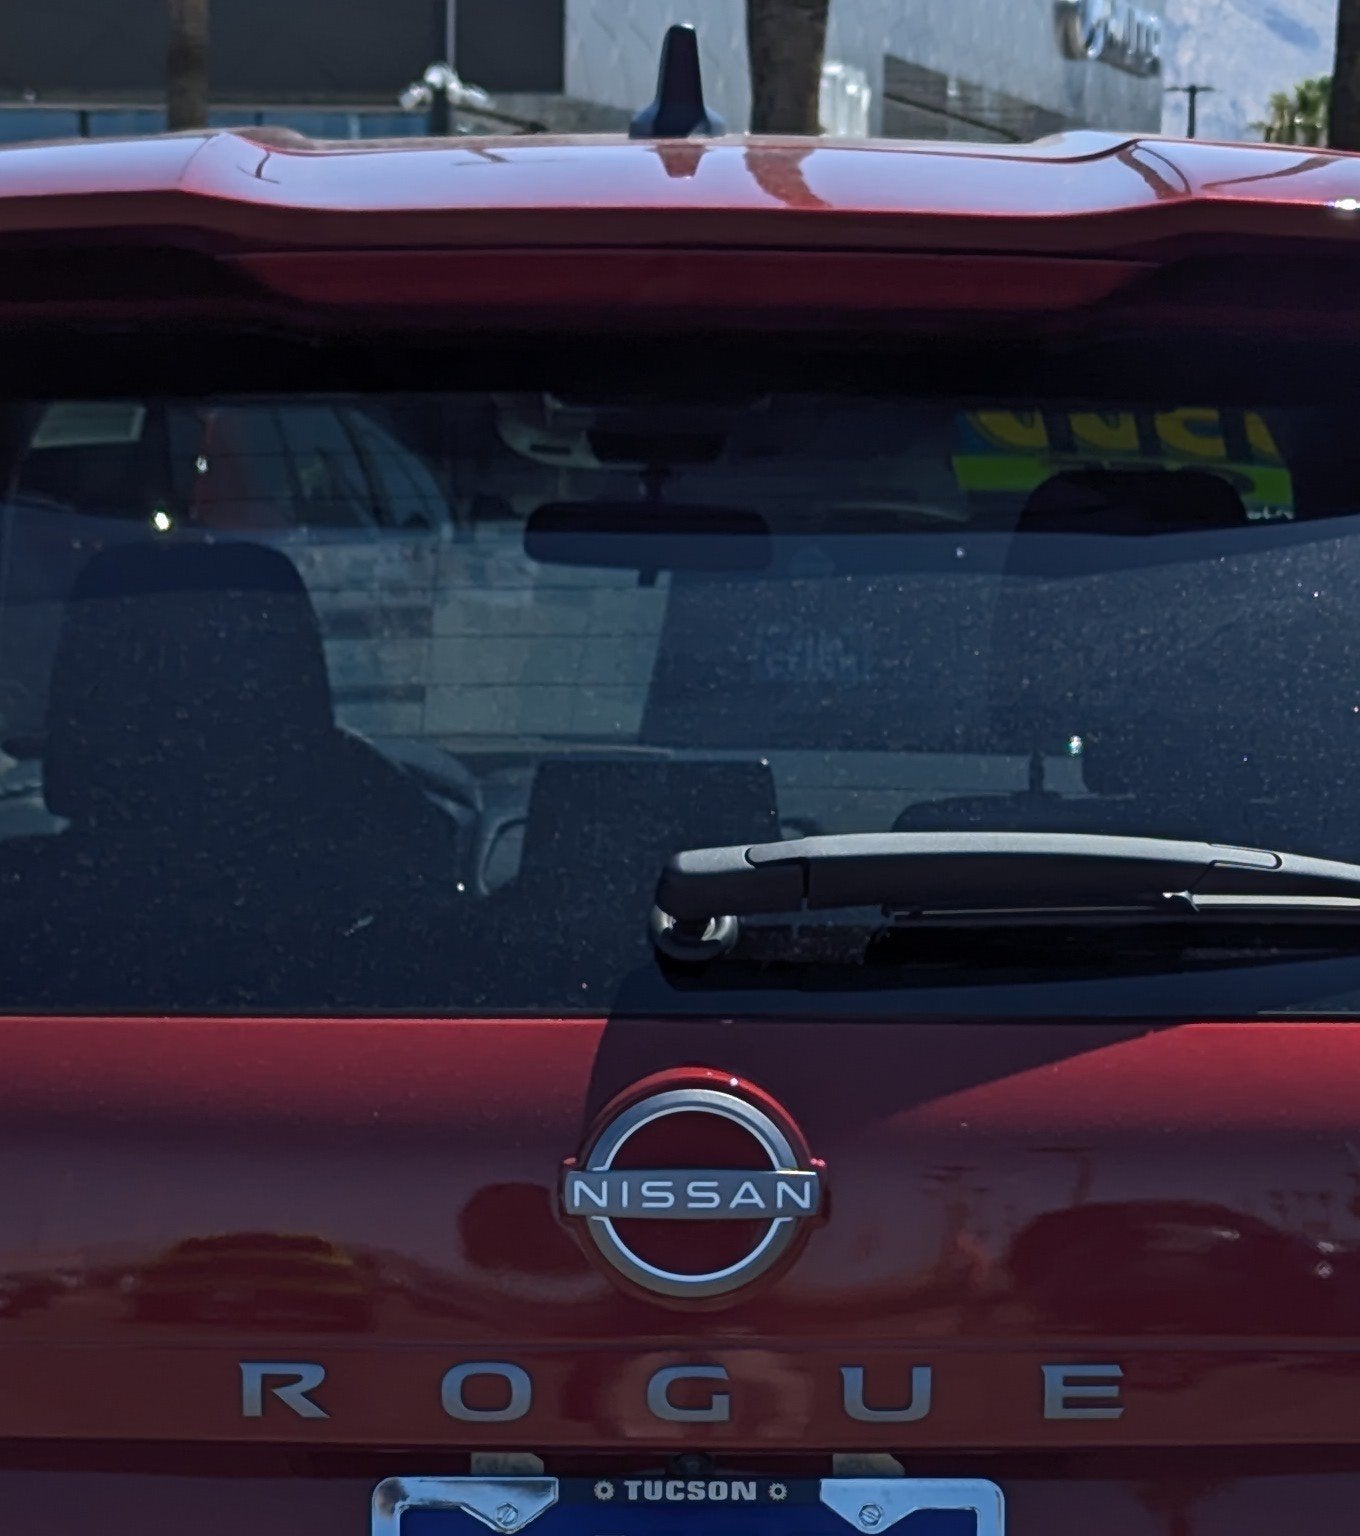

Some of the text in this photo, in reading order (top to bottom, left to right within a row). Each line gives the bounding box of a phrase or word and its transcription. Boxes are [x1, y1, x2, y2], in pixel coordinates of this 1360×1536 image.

[572, 1180, 812, 1210] NISSAN
[239, 1360, 1126, 1423] ROGUE
[623, 1479, 757, 1502] TUCSON
